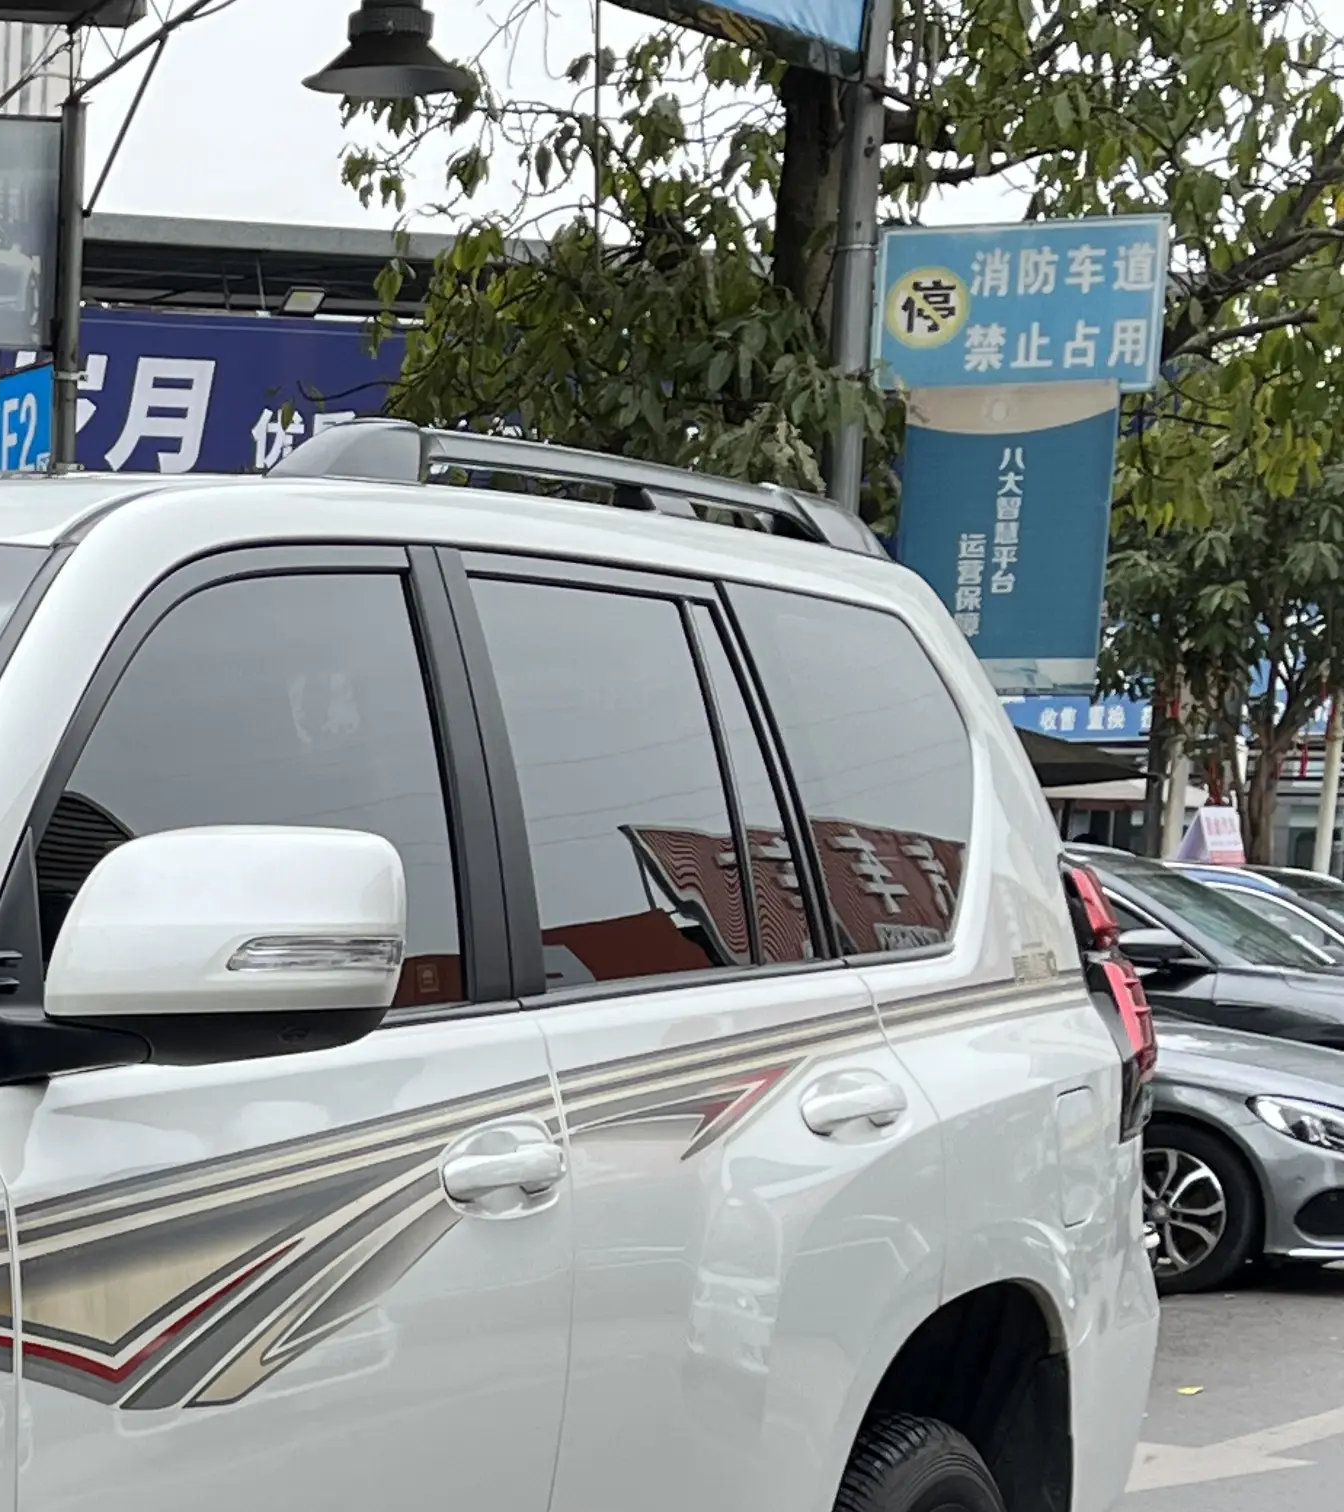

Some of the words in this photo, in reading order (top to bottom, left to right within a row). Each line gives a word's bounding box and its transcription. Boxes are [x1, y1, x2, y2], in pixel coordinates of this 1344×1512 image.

[970, 242, 1156, 298] 消防车道
[900, 279, 957, 334] 停
[963, 317, 1149, 372] 禁止占用
